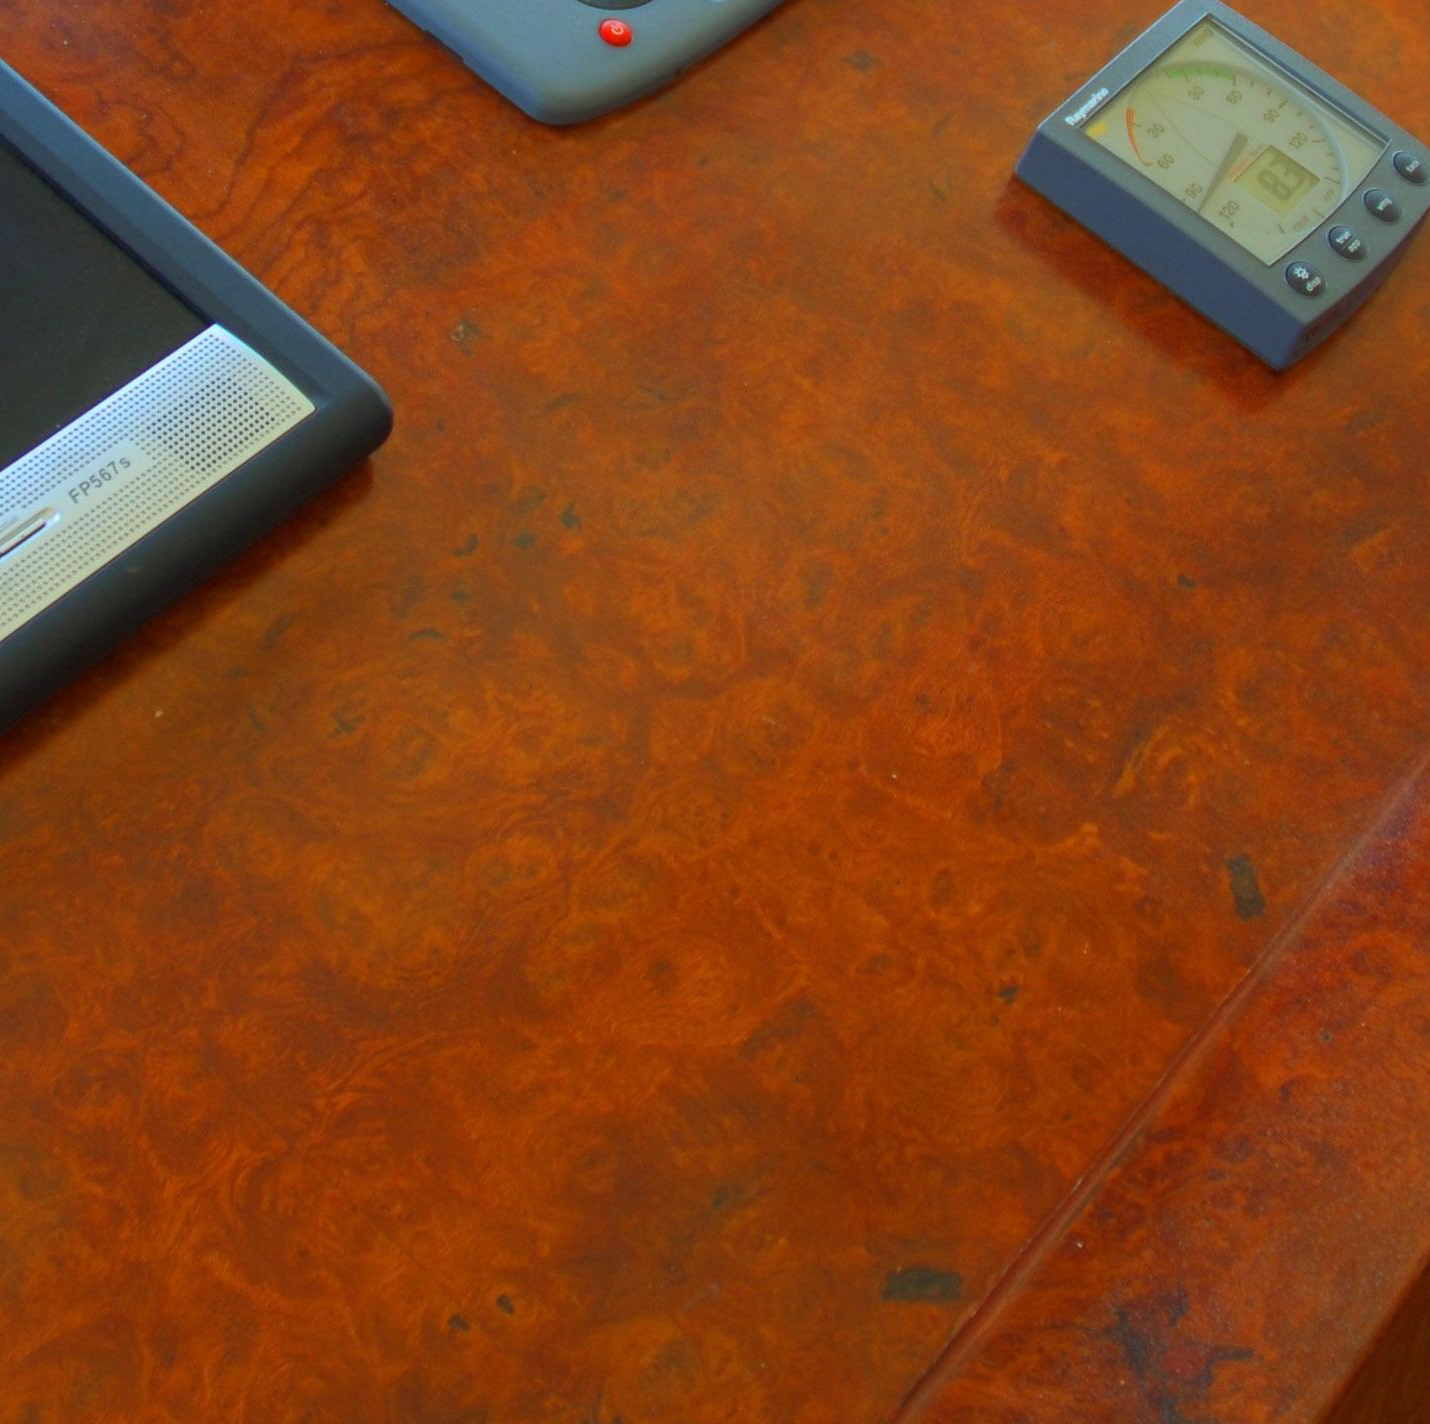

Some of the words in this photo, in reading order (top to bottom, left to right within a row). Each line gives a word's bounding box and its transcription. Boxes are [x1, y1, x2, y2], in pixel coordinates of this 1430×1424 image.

[1187, 84, 1206, 102] 30
[1225, 89, 1243, 106] 60
[1263, 108, 1281, 124] 90
[1146, 122, 1166, 139] 30
[1288, 131, 1309, 150] 120
[1156, 153, 1176, 171] 60
[1184, 182, 1204, 200] 90
[1218, 200, 1241, 221] 120
[67, 456, 132, 505] FP567s
